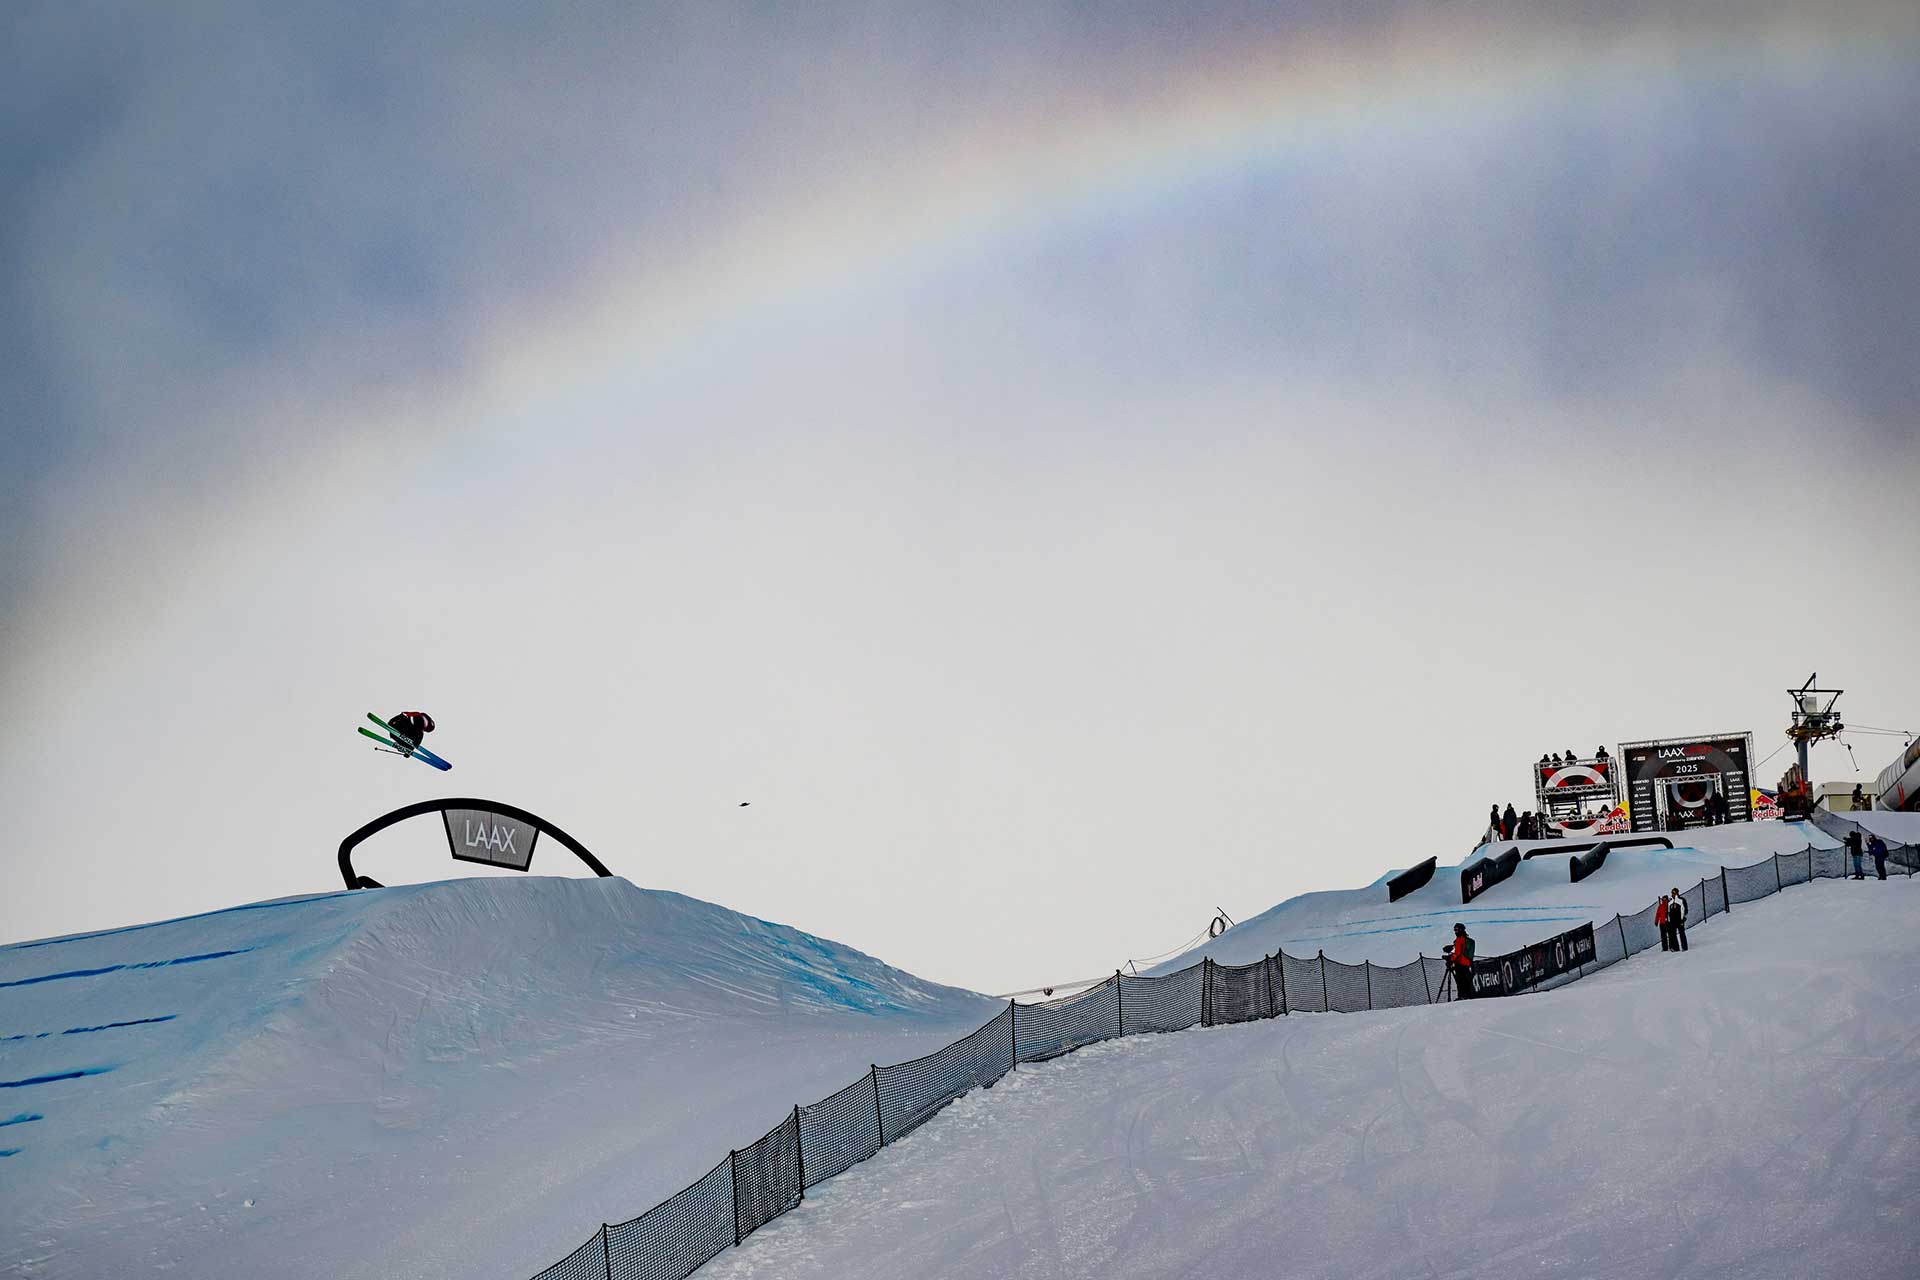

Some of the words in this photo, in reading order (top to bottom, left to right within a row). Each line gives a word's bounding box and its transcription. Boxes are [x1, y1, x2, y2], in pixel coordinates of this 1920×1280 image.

[1658, 747, 1686, 758] LAAX
[1676, 764, 1698, 774] 2025
[466, 820, 516, 854] LAAX
